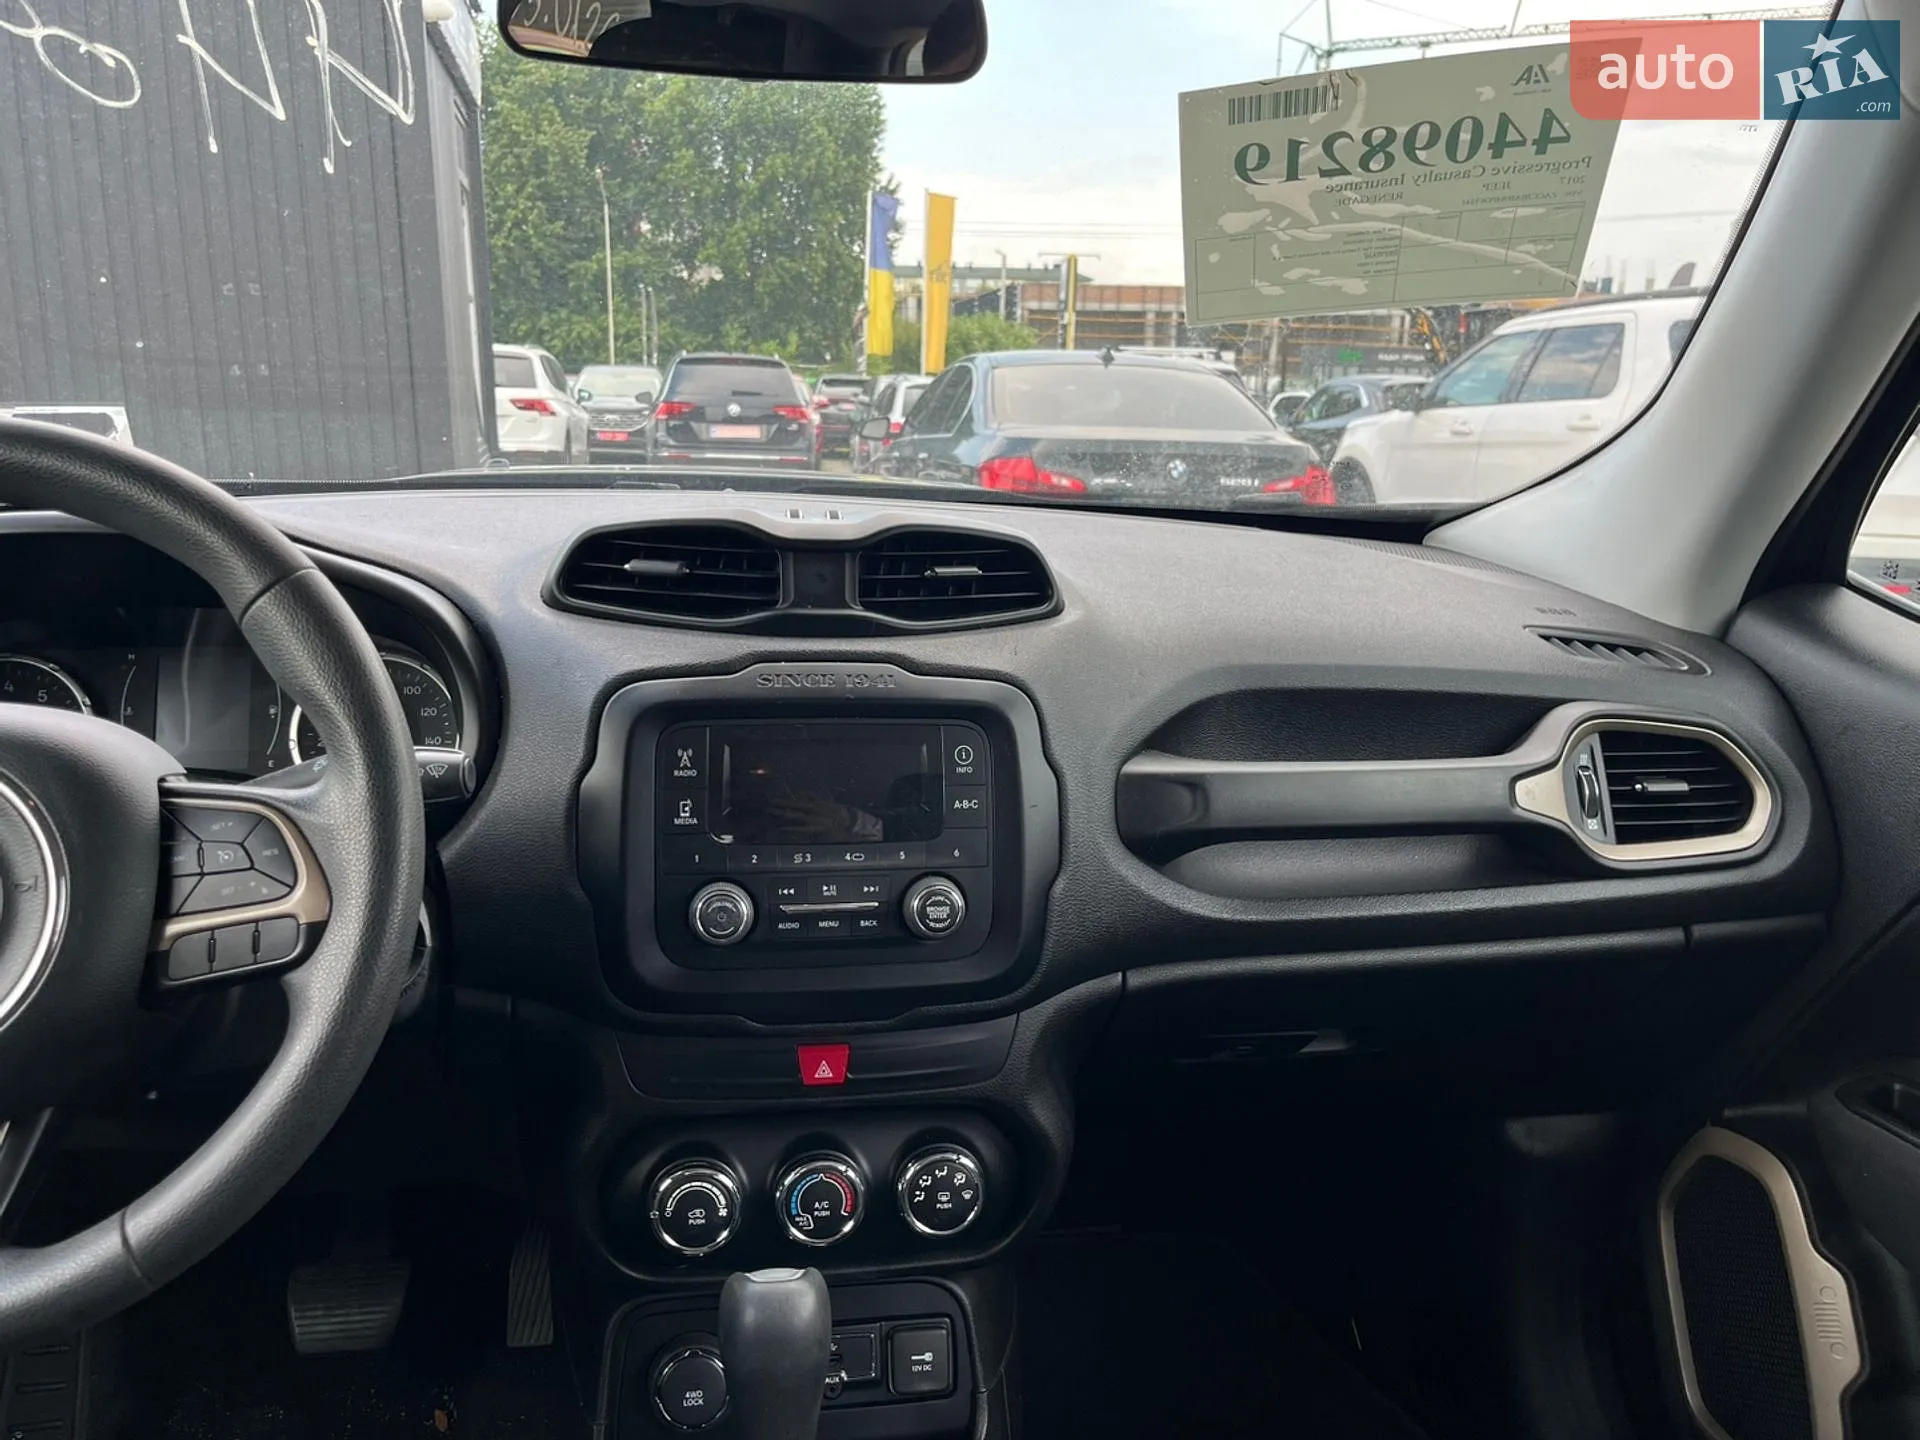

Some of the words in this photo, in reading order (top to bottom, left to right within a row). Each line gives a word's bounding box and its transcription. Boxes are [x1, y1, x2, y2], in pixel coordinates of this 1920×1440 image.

[756, 673, 836, 688] SINCE
[845, 673, 896, 688] 1941
[4, 680, 13, 692] 4
[403, 685, 422, 695] 100
[37, 690, 48, 702] 5
[420, 707, 437, 717] 120
[425, 736, 442, 745] 140
[673, 769, 697, 778] RADIO
[956, 766, 973, 774] INFO
[673, 817, 698, 826] MEDIA
[805, 853, 812, 863] 3
[845, 852, 852, 862] 4
[899, 850, 906, 860] 5
[953, 849, 960, 858] 6
[751, 854, 758, 864] 2
[818, 920, 840, 928] MENU
[859, 919, 878, 927] BACK
[814, 1200, 830, 1210] A/C
[936, 1202, 952, 1210] PUSH
[814, 1210, 831, 1218] PUSH
[688, 1216, 706, 1226] PUSH
[911, 1364, 922, 1372] 12V
[922, 1364, 933, 1372] DC
[825, 1375, 841, 1385] AUX
[685, 1390, 704, 1399] 4WD
[682, 1398, 705, 1407] LOCK
